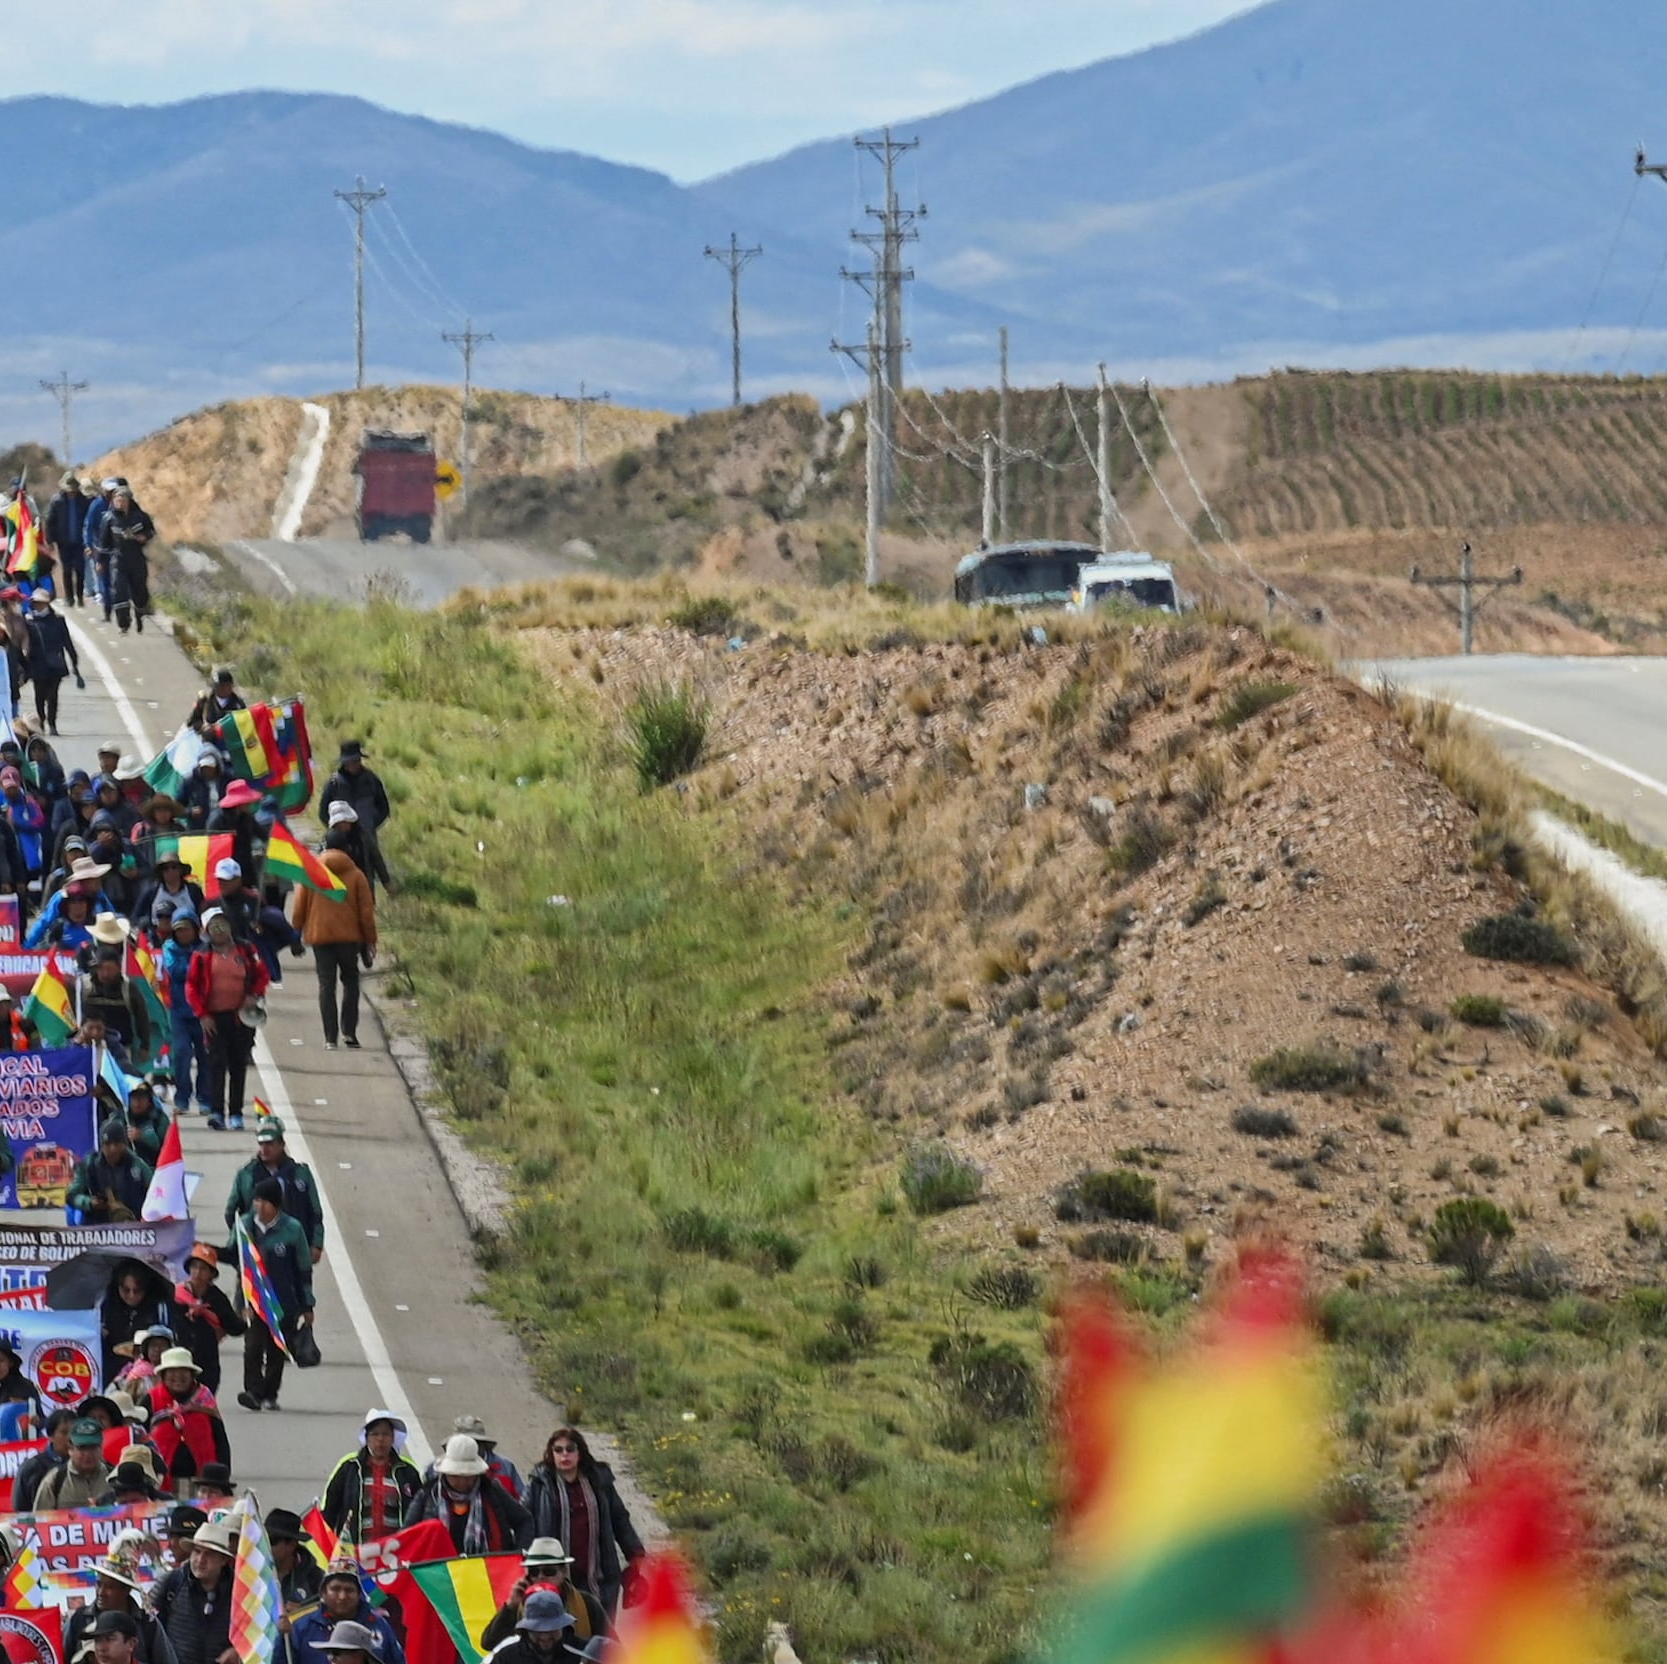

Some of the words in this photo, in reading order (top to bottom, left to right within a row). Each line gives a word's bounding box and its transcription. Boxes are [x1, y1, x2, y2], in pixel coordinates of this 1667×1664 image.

[40, 1231, 57, 1246] DE
[59, 1229, 156, 1246] TRABAJADORES
[20, 1246, 36, 1260] DE
[39, 1361, 90, 1377] COB
[49, 1523, 84, 1547] DE
